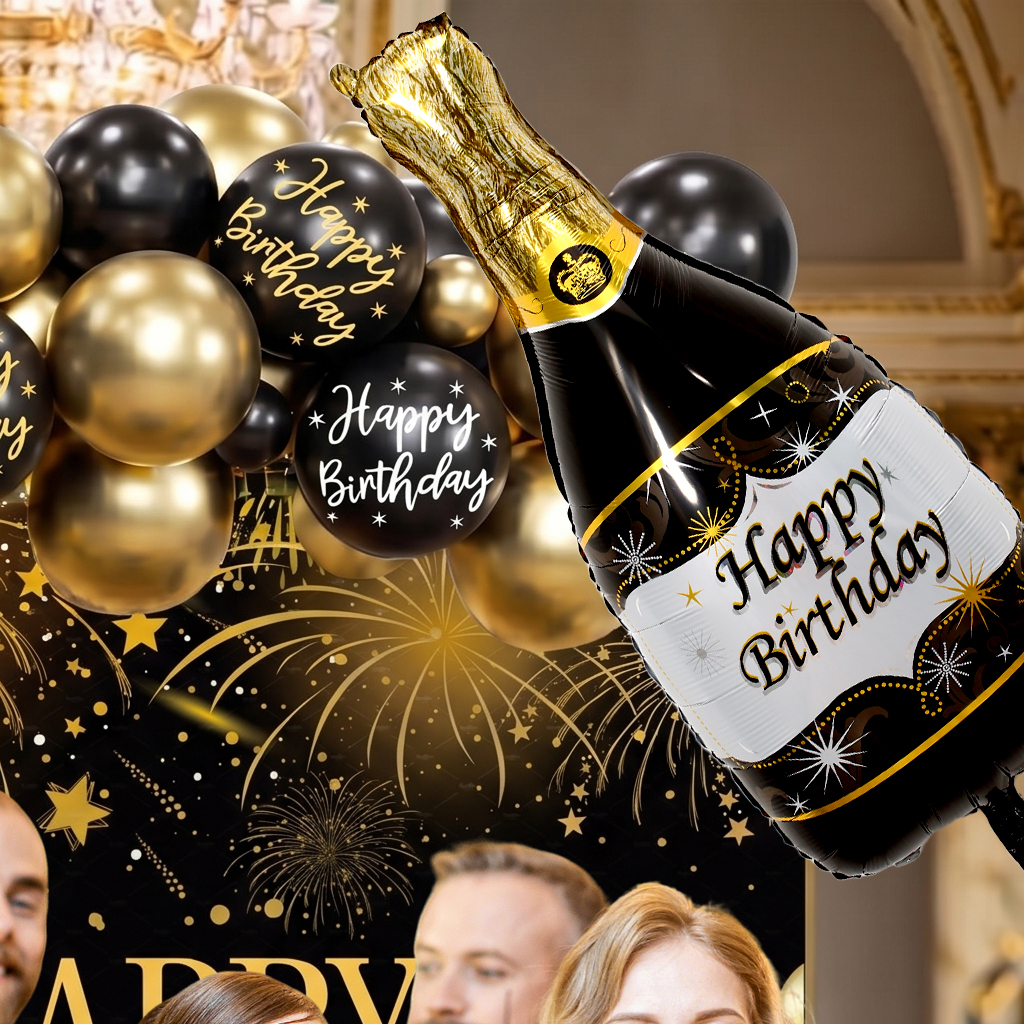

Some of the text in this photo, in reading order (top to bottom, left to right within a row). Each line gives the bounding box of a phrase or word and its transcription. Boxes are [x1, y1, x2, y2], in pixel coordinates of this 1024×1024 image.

[226, 197, 356, 347] Birthday
[273, 157, 395, 295] Happy
[319, 453, 494, 513] Birthday
[328, 382, 480, 453] Happy
[715, 457, 885, 612] Happy
[739, 508, 950, 692] Birthday
